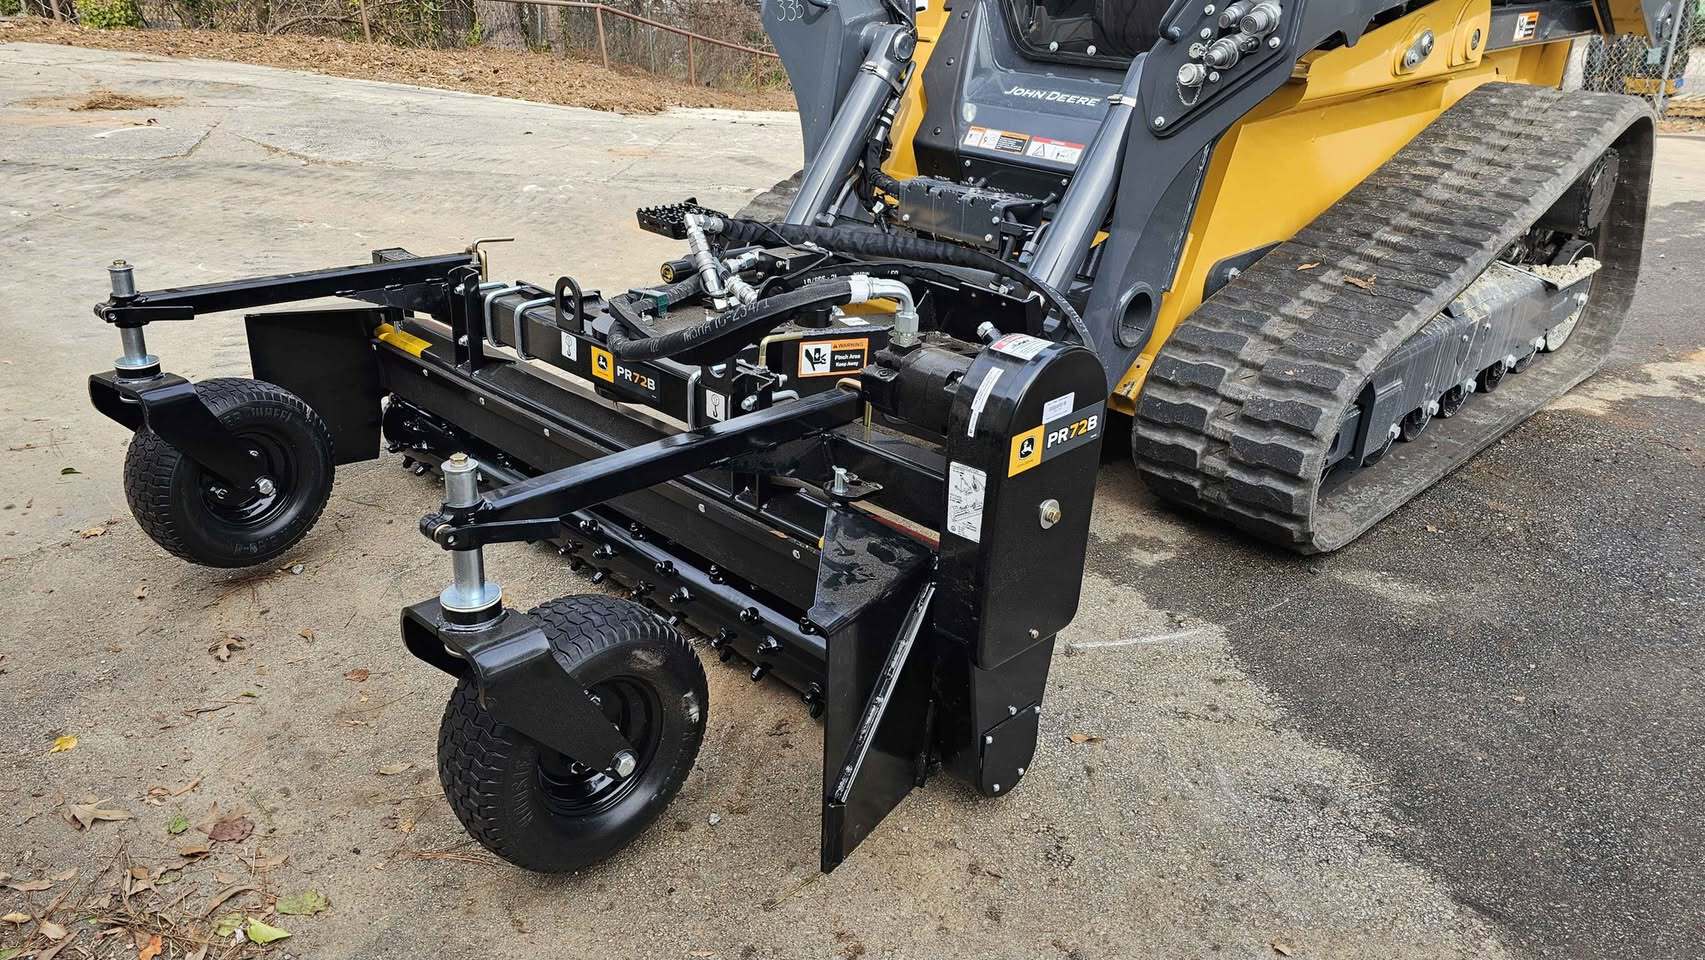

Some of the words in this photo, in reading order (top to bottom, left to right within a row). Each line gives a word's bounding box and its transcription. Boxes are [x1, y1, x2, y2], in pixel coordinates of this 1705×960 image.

[1004, 85, 1047, 100] JOHN
[1047, 91, 1101, 107] DEERE
[616, 365, 656, 391] PR72B
[1047, 415, 1098, 449] PR72B
